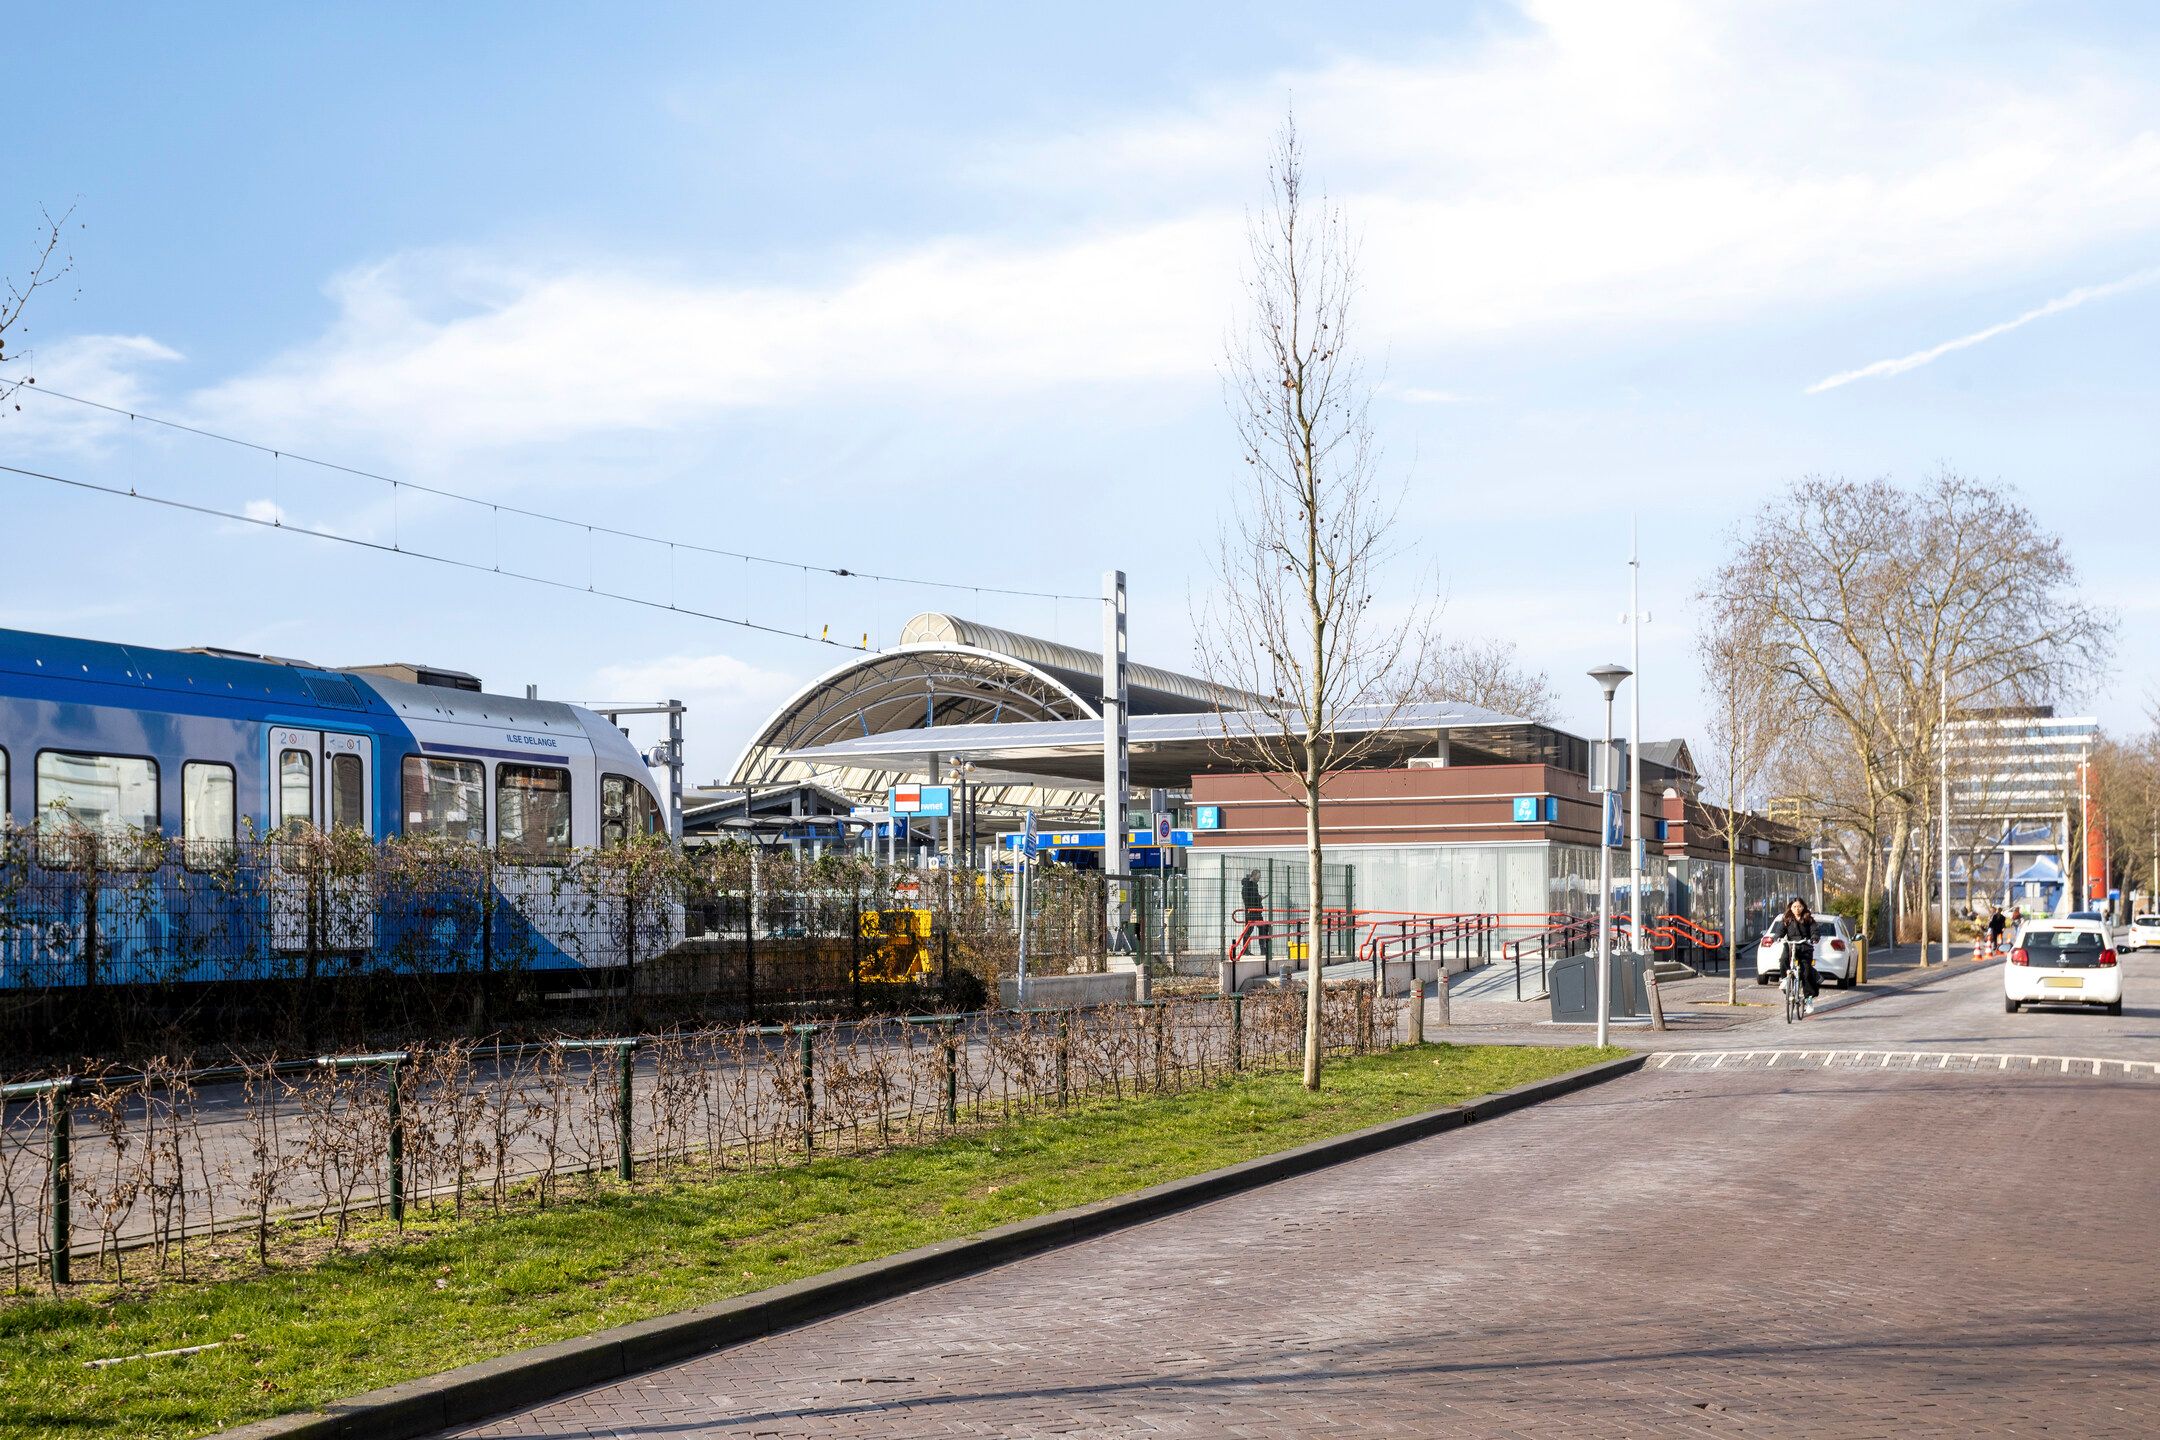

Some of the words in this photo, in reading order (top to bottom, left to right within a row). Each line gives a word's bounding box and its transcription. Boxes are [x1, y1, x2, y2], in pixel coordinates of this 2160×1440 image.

[280, 731, 287, 745] 2
[356, 739, 361, 751] 1
[506, 734, 523, 744] ILSE
[523, 736, 557, 748] DELANGE
